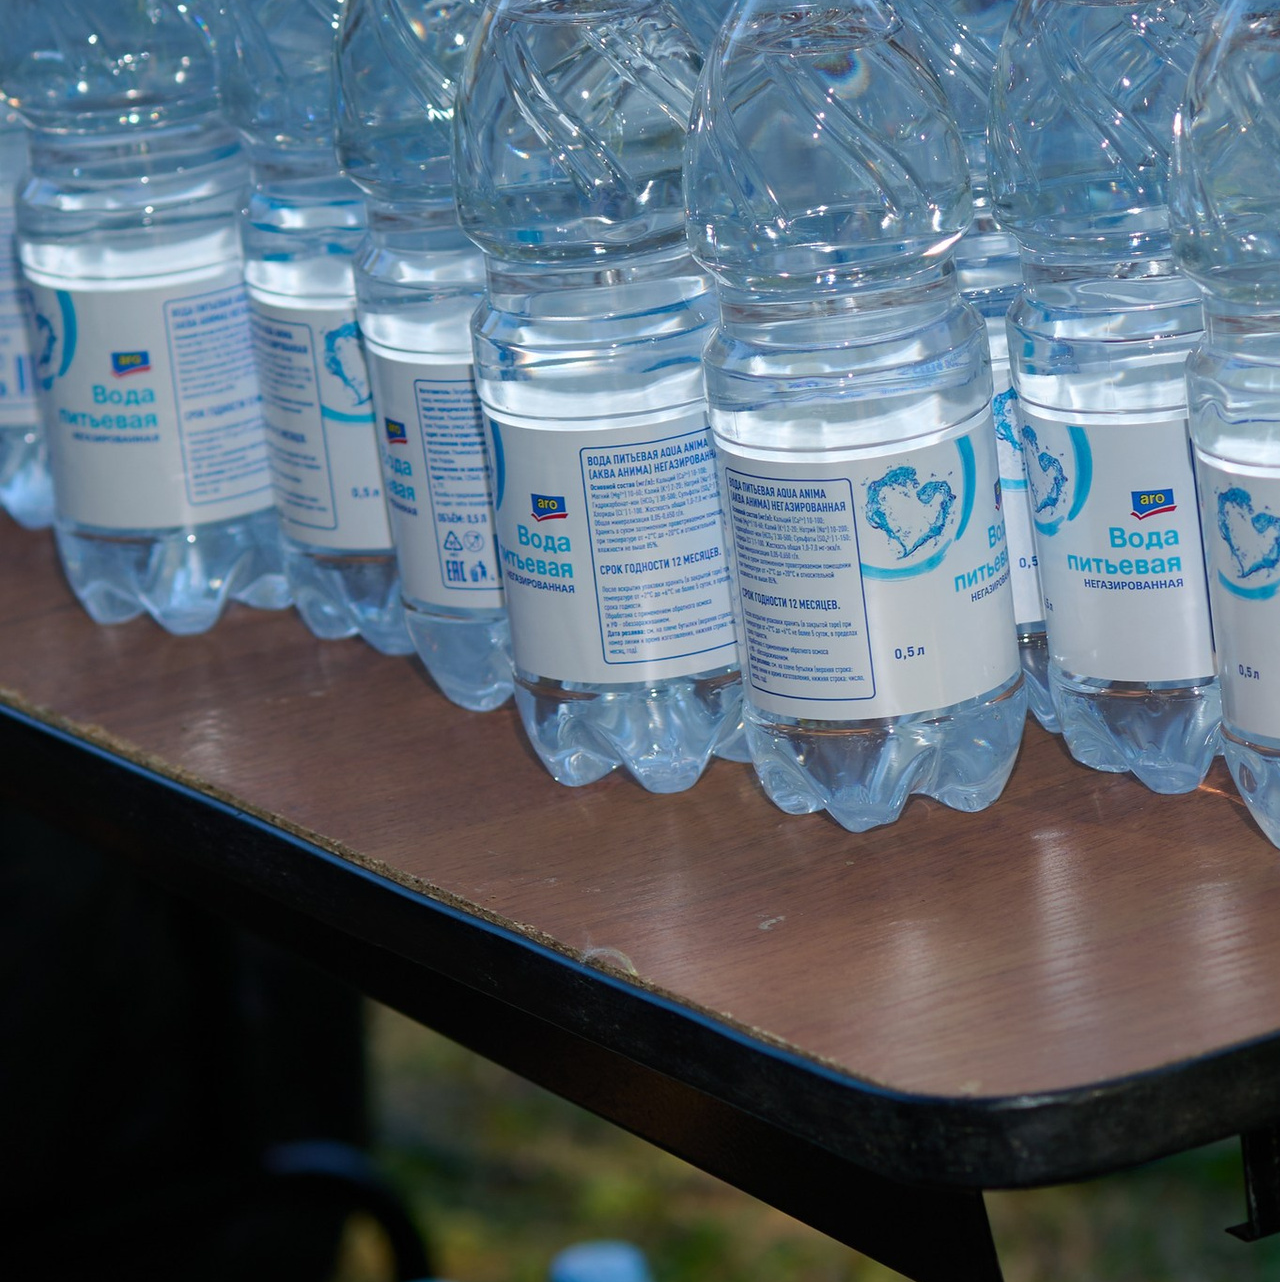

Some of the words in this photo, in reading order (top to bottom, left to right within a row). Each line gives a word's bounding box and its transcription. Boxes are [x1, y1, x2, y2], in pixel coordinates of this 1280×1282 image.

[92, 385, 156, 406] Вода
[587, 455, 612, 467] ВОДА
[613, 450, 658, 466] ПИТЬЕВАЯ
[660, 445, 682, 458] AQUA
[684, 438, 708, 452] ANIMA
[588, 468, 616, 480] (АКВА
[618, 464, 652, 478] АНИМА)
[742, 481, 775, 498] ПИТЬЕВАЯ
[776, 488, 798, 499] AQUA
[800, 488, 826, 499] ANIMA
[537, 498, 558, 510] aro
[771, 501, 846, 512] НЕГАЗИРОВАННАЯ
[1140, 493, 1166, 505] aro
[517, 524, 572, 554] Вода
[987, 520, 1006, 550] Во
[1108, 526, 1180, 550] Вода
[600, 563, 623, 576] СРОК
[625, 558, 670, 574] ГОДНОСТИ
[672, 556, 682, 567] 12
[684, 548, 722, 566] МЕСЯЦЕВ.
[954, 545, 1010, 593] питьев
[1018, 556, 1038, 570] 0,5
[1067, 554, 1182, 576] питьевая
[1084, 578, 1184, 590] НЕГАЗИРОВАННАЯ
[755, 594, 788, 608] ГОДНОСТИ
[789, 599, 797, 609] 12
[799, 599, 840, 611] МЕСЯЦЕВ.
[894, 646, 914, 660] 0,5
[917, 645, 925, 656] л
[1238, 664, 1252, 678] 0,5
